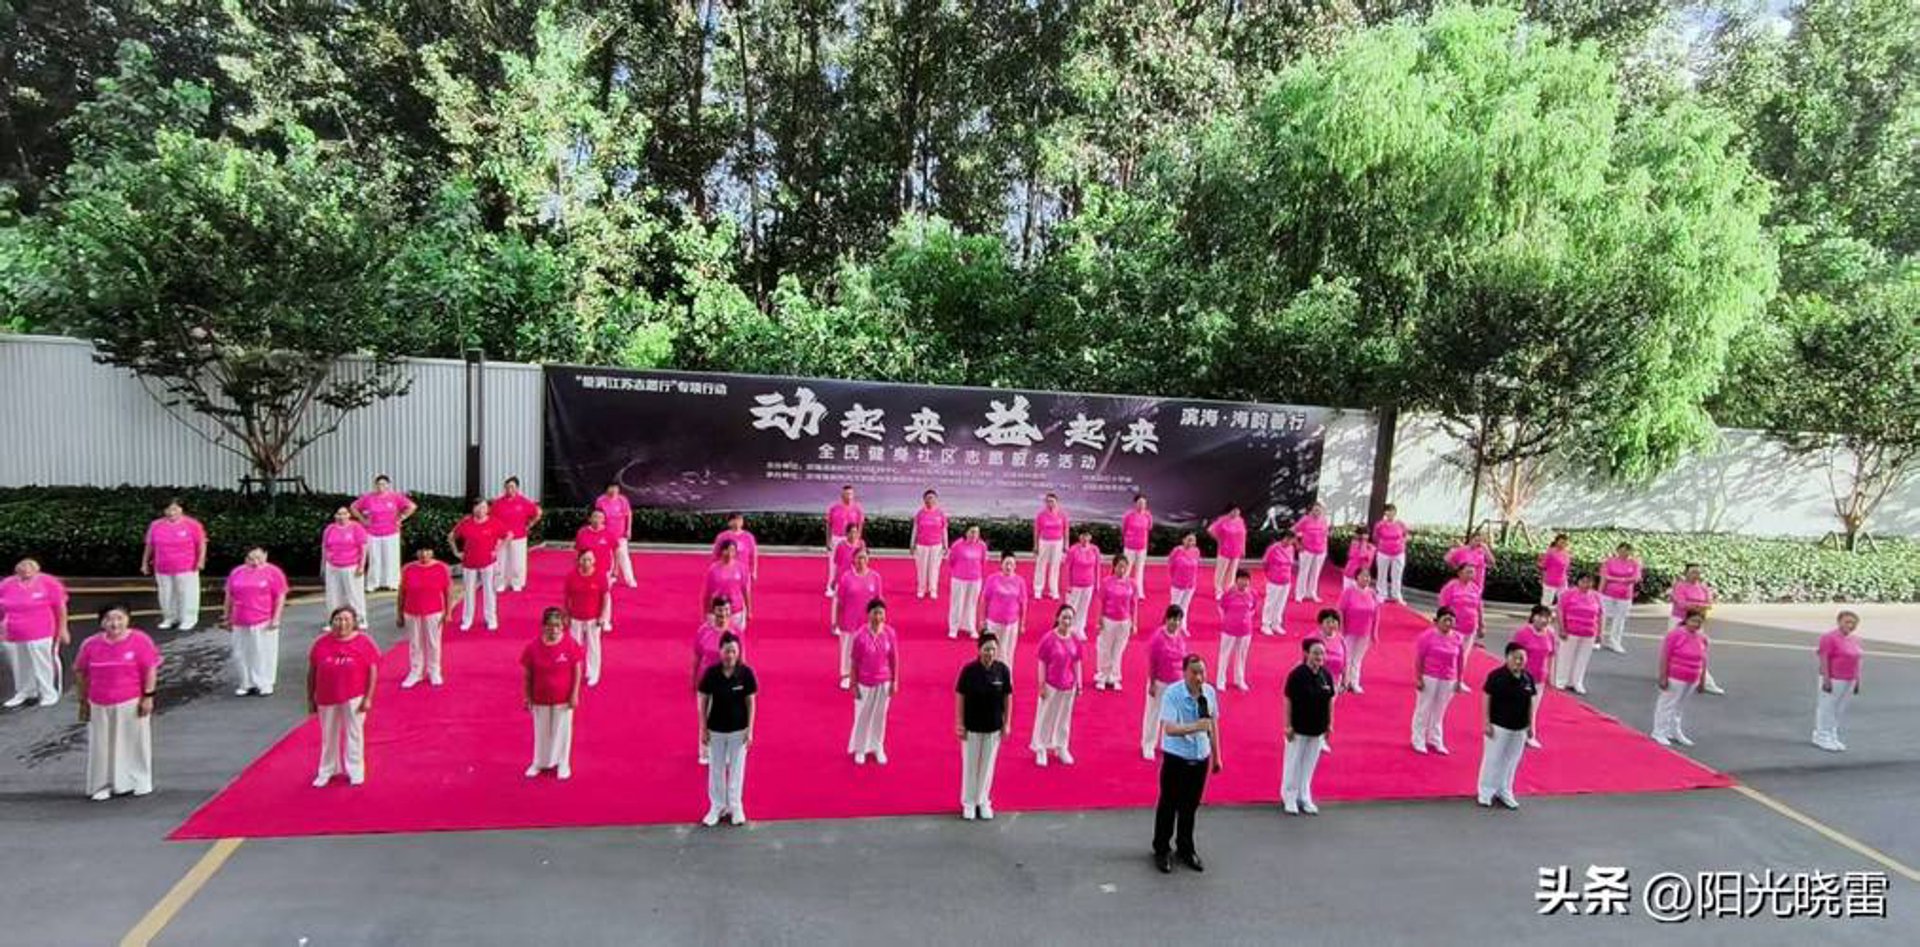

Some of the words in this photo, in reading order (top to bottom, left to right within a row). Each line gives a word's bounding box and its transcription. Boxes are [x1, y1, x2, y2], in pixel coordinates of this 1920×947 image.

[817, 443, 1096, 470] 全民健身社区志愿服务活动
